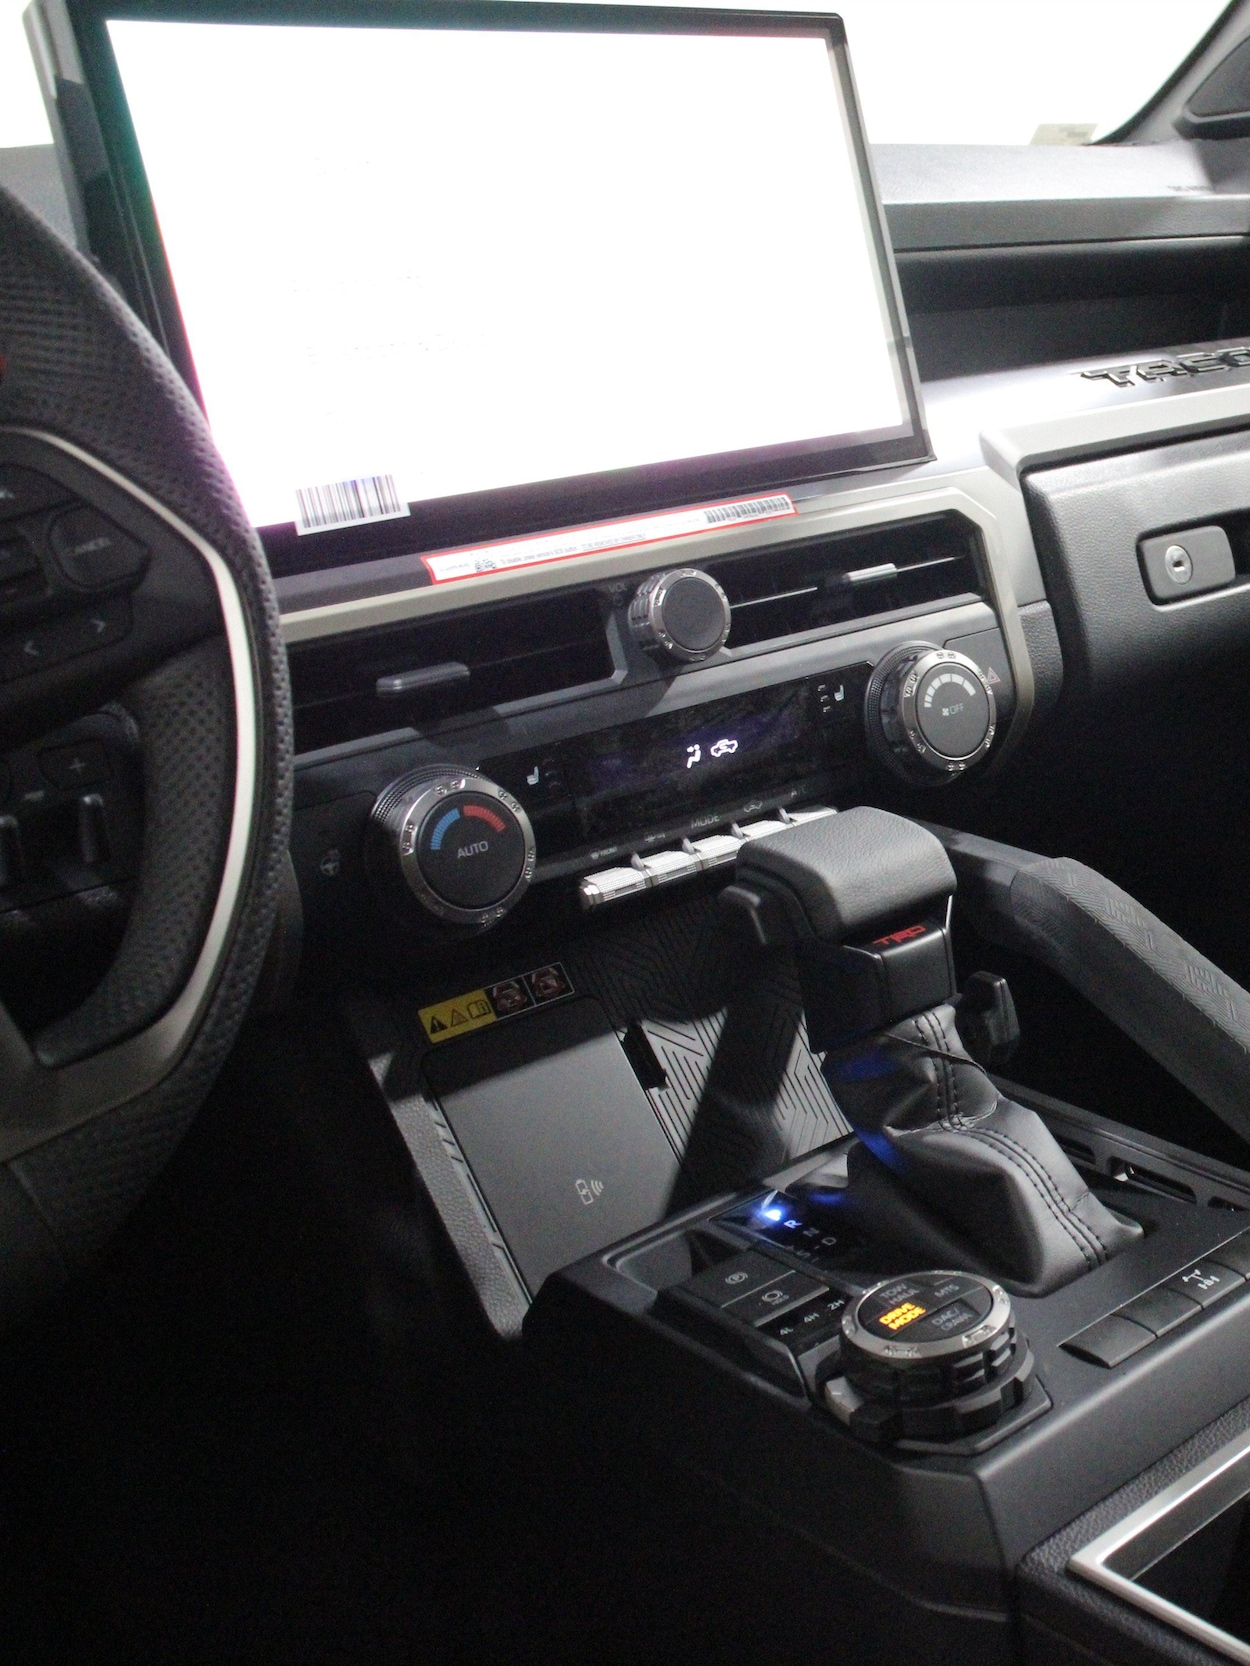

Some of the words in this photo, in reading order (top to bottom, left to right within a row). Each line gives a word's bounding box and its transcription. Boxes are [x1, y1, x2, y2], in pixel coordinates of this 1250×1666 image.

[949, 703, 965, 715] OFF
[691, 815, 720, 829] MODE
[457, 841, 489, 859] AUTO
[783, 1219, 803, 1229] R
[880, 1283, 908, 1299] TOW
[934, 1283, 960, 1298] MTS
[826, 1299, 845, 1311] 2H
[803, 1312, 820, 1323] 4H
[879, 1302, 916, 1325] DRIVE
[888, 1306, 926, 1331] MODE
[779, 1326, 794, 1336] 4L
